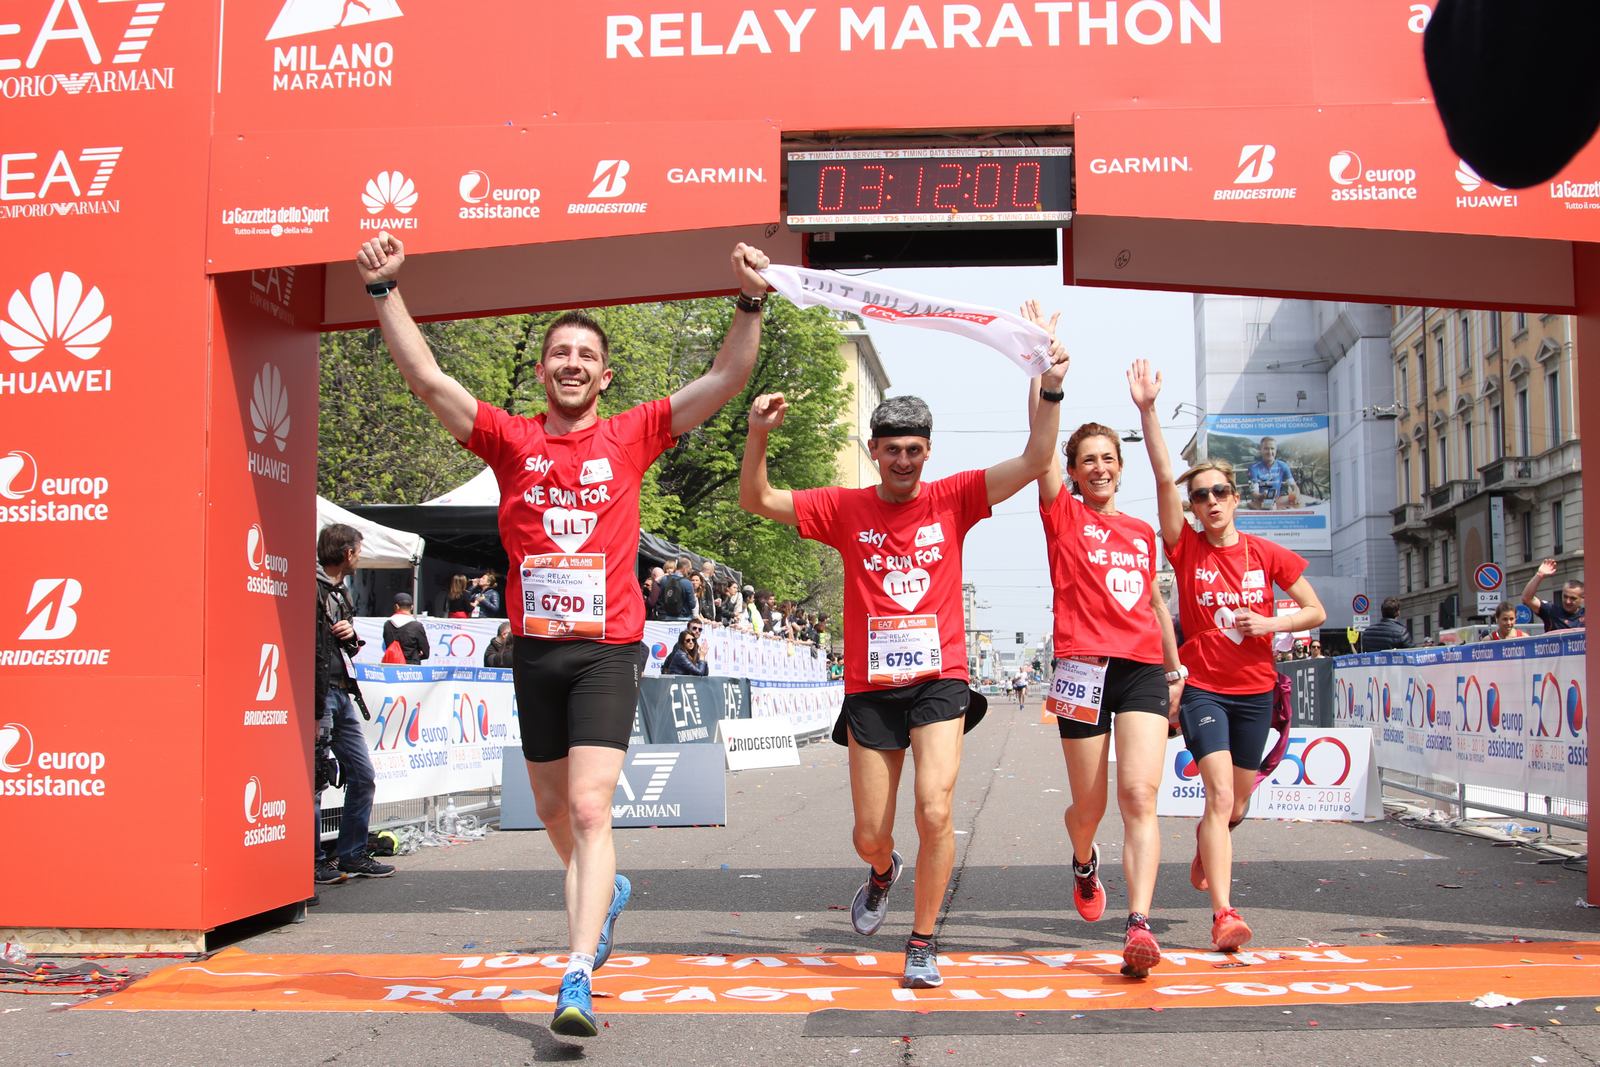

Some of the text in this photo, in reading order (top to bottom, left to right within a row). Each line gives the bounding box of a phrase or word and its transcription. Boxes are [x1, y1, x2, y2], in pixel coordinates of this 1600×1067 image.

[606, 0, 1222, 58] RELAY MARATHON
[273, 41, 394, 72] MILANO
[273, 70, 393, 91] MARATHON
[0, 146, 124, 200] EA7
[1365, 168, 1416, 184] europ
[492, 188, 540, 204] europ
[818, 162, 1040, 211] 03:12:00
[1213, 187, 1297, 200] BRIDGESTONE
[1331, 184, 1417, 201] assistance
[459, 204, 540, 219] assistance
[568, 202, 647, 214] BRIDGESTONE
[1456, 196, 1518, 208] HUAWEI
[360, 218, 418, 230] HUAWEI
[0, 370, 112, 395] HUAWEI
[248, 450, 290, 484] HUAWEI
[524, 454, 555, 478] sky
[41, 476, 109, 500] europ
[524, 484, 611, 508] WE RUN FOR
[0, 499, 109, 523] assistance
[551, 518, 594, 536] LILT
[1083, 524, 1112, 544] sky
[858, 528, 887, 548] sky
[264, 552, 289, 578] europ
[864, 546, 943, 572] WE RUN FOR
[1088, 548, 1109, 566] WE
[1110, 551, 1136, 568] RUN
[246, 574, 289, 598] assistance
[1112, 578, 1142, 594] LILT
[1195, 568, 1219, 585] sky
[890, 578, 927, 596] LILT
[542, 594, 585, 613] 679D
[1216, 592, 1240, 606] RUN
[1242, 590, 1264, 605] FOR
[548, 620, 577, 633] EA7
[0, 648, 111, 666] RIDGESTONE
[886, 651, 924, 668] 679C
[1055, 678, 1087, 700] 679B
[670, 683, 703, 729] EA7
[1056, 700, 1077, 715] EA7
[1456, 675, 1483, 733] 50
[1530, 672, 1563, 738] 50
[244, 710, 289, 726] BRIDGESTONE
[1501, 712, 1524, 737] europ
[422, 726, 449, 746] europ
[729, 736, 793, 752] BRIDGESTONE
[1488, 735, 1524, 760] assistance
[38, 752, 106, 775] europ
[408, 748, 448, 770] assistance
[1272, 736, 1351, 786] 50
[1268, 790, 1351, 804] 1968 2018
[262, 798, 287, 820] europ
[626, 804, 681, 819] ARMANI
[1319, 804, 1351, 812] FUTURO
[244, 822, 286, 848] assistance
